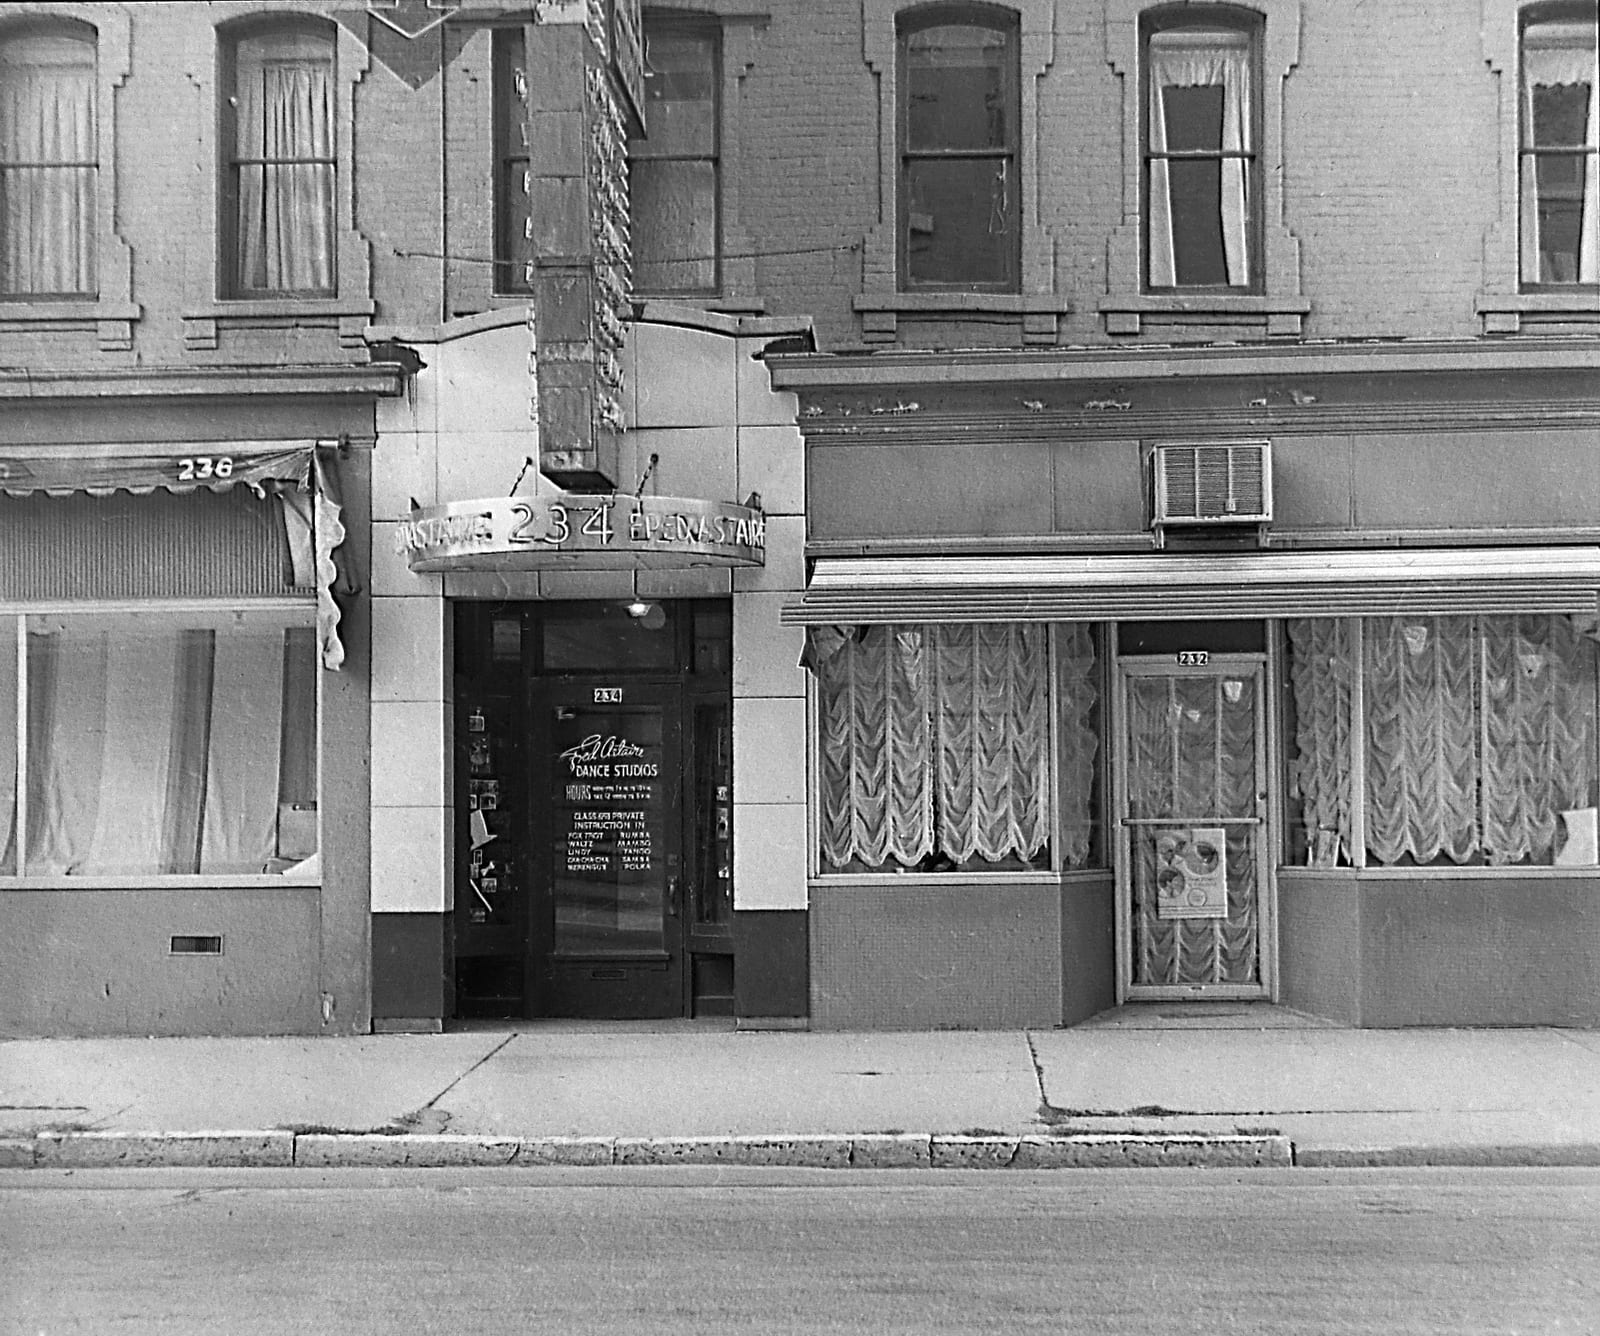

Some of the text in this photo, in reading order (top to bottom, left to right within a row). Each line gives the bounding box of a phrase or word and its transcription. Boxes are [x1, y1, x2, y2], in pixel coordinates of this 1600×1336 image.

[178, 457, 233, 480] 236
[509, 502, 614, 545] 234
[1180, 652, 1208, 665] 232
[595, 689, 621, 702] 234
[576, 764, 658, 777] DANCE STUDIOS
[565, 785, 591, 800] HOURS
[612, 811, 644, 820] PRIVATE
[574, 821, 645, 830] INSTRUCTION IN
[568, 840, 593, 848] WALTZ
[617, 840, 651, 848] MAMBO
[624, 863, 651, 871] POLKA
